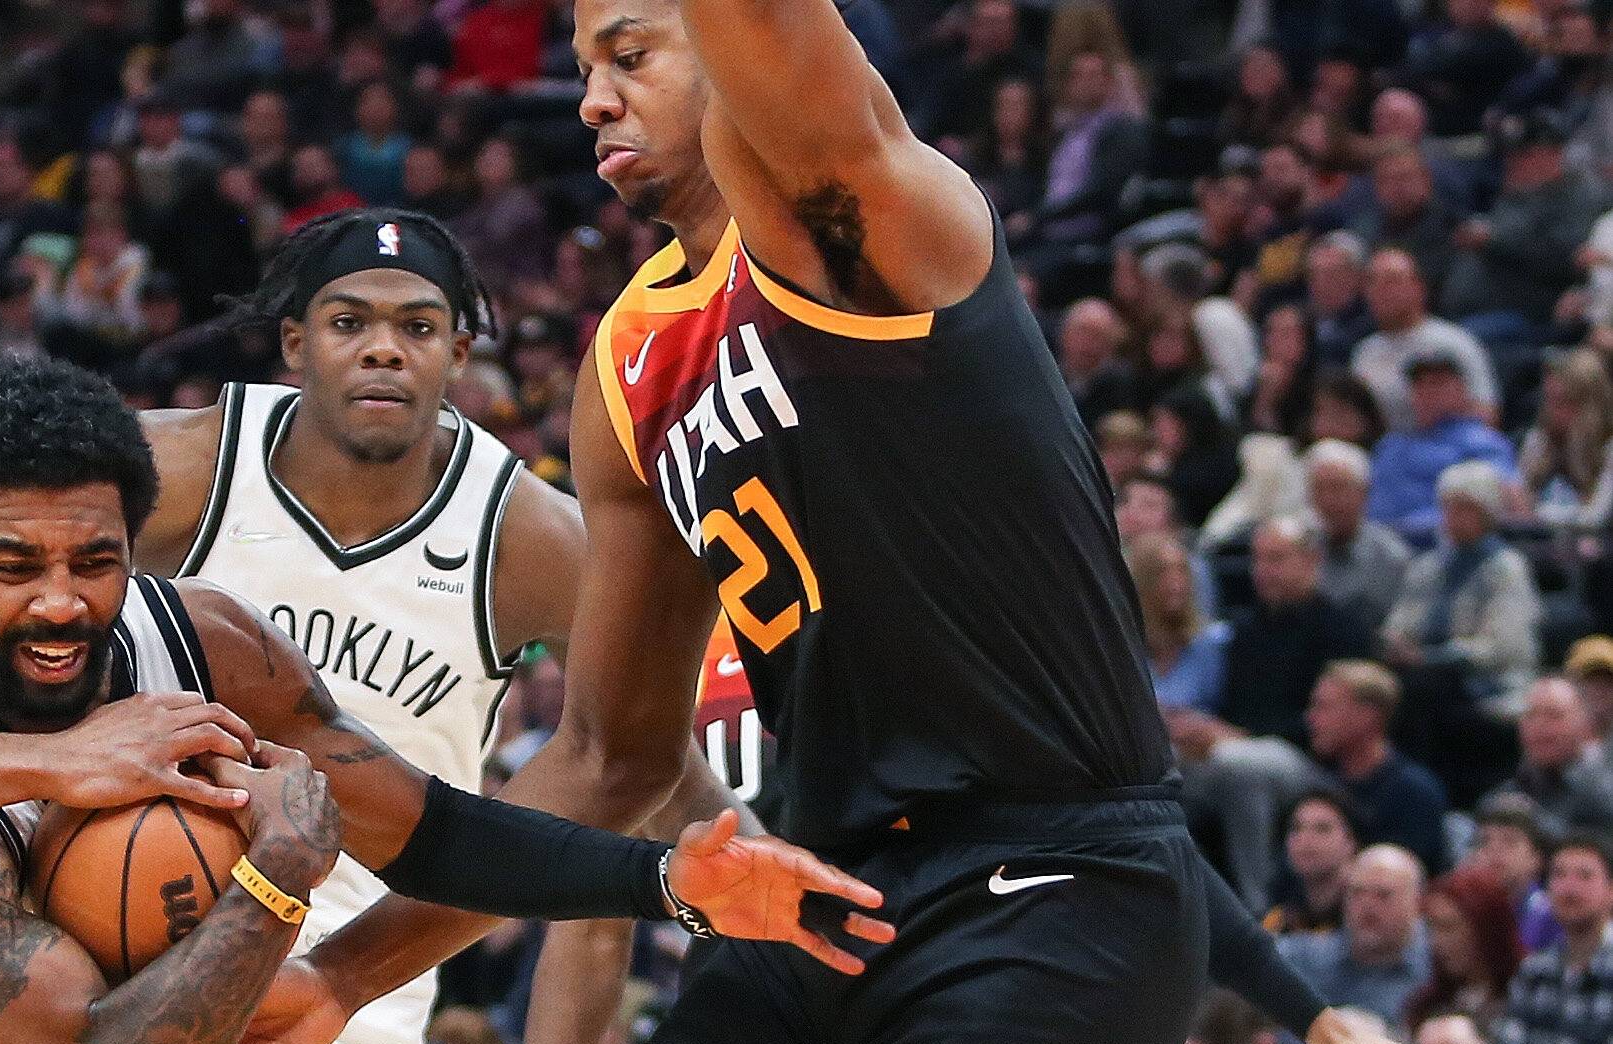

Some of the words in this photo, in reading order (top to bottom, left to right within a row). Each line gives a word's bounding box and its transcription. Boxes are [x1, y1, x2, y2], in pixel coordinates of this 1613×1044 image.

[657, 323, 798, 557] UTAH
[417, 576, 464, 595] Webull
[703, 476, 821, 654] 21
